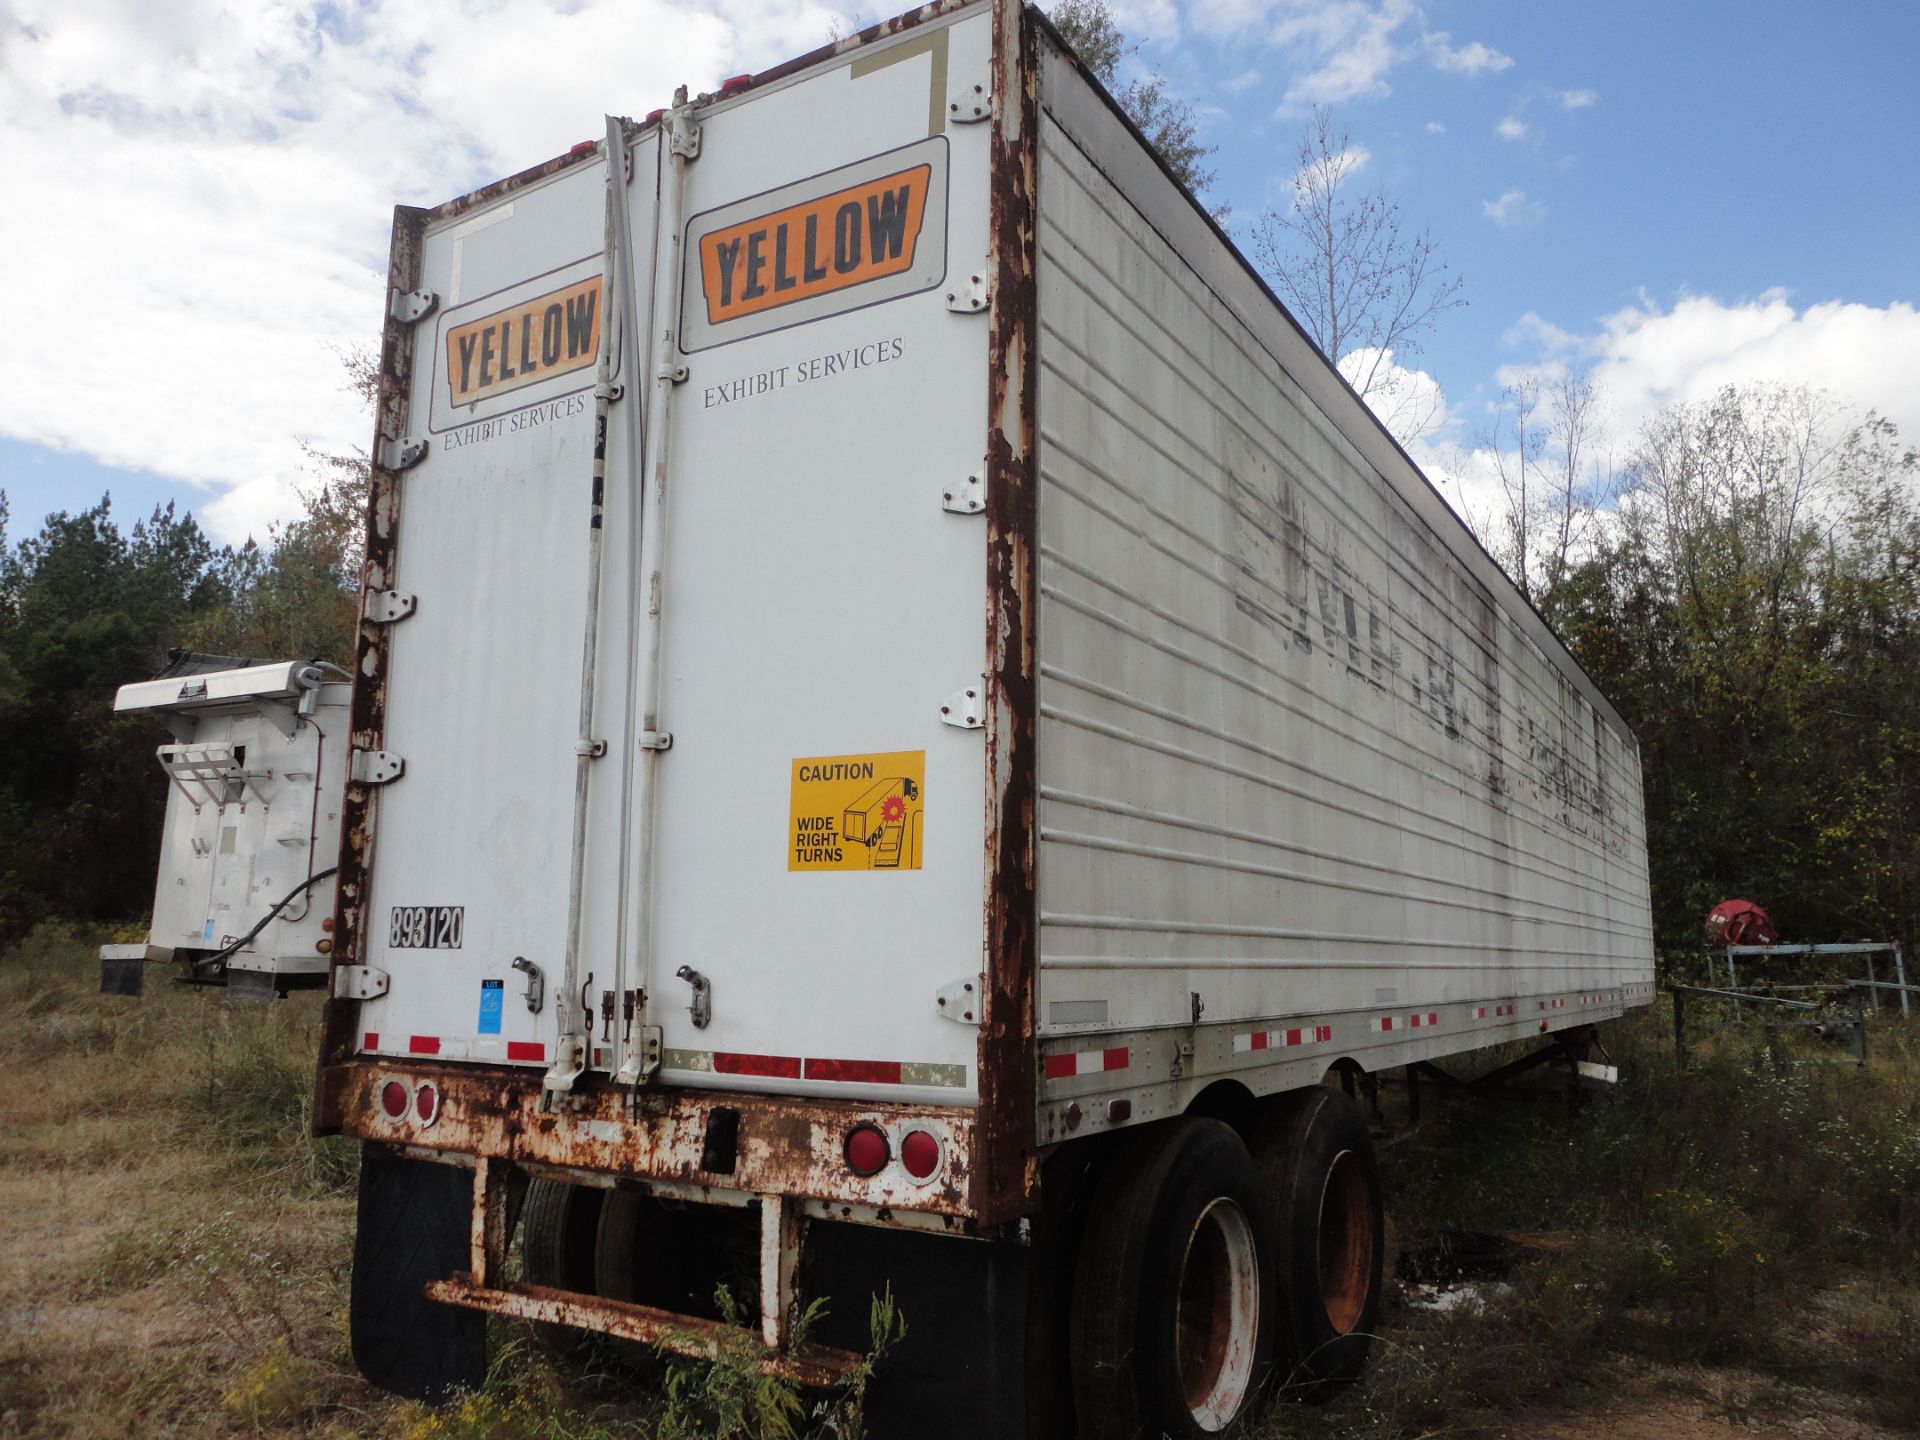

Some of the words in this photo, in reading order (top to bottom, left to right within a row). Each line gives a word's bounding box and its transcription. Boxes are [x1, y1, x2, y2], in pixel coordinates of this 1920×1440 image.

[716, 184, 911, 308] YELLOW
[459, 289, 597, 394] YELLOW
[704, 367, 789, 409] EXHIBIT
[797, 337, 904, 383] SERVICES
[444, 417, 506, 451] EXHIBIT
[510, 394, 585, 433] SERVICES
[799, 762, 873, 782] CAUTION
[796, 832, 839, 847] RIGHT
[797, 816, 834, 831] WIDE
[795, 848, 843, 862] TURNS
[390, 906, 464, 949] 893120
